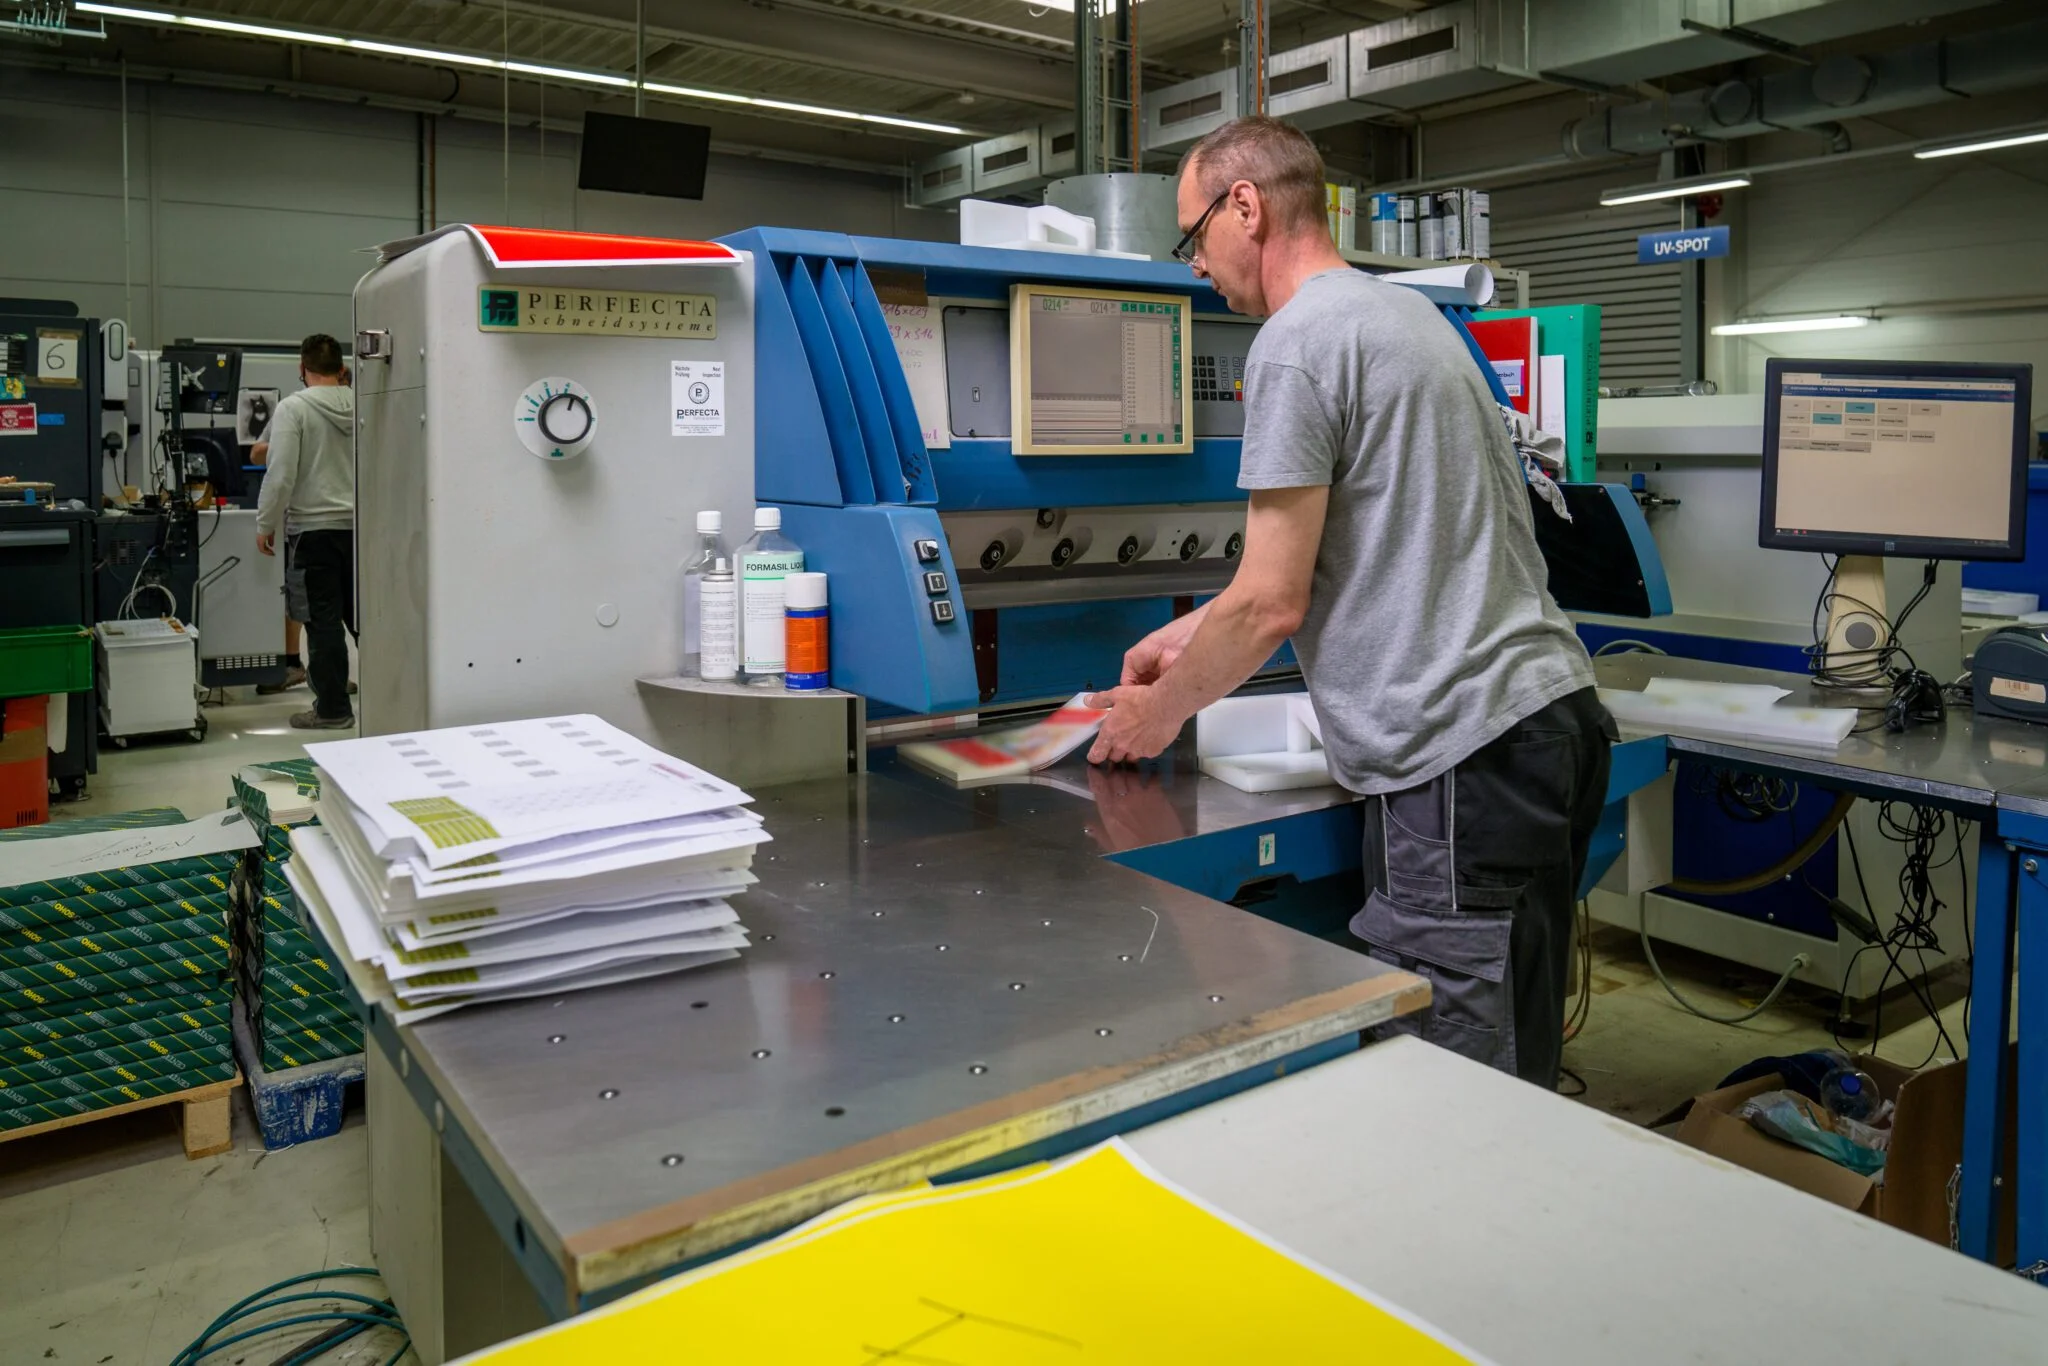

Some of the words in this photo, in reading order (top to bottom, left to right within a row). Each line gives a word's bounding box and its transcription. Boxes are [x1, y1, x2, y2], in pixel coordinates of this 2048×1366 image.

[1653, 236, 1711, 256] UV-SPOT
[528, 292, 713, 317] PERFECTA
[528, 313, 713, 332] Schneidsysteme
[46, 342, 65, 370] 6
[676, 408, 720, 420] PERFECTA
[746, 562, 789, 572] FORMASIL
